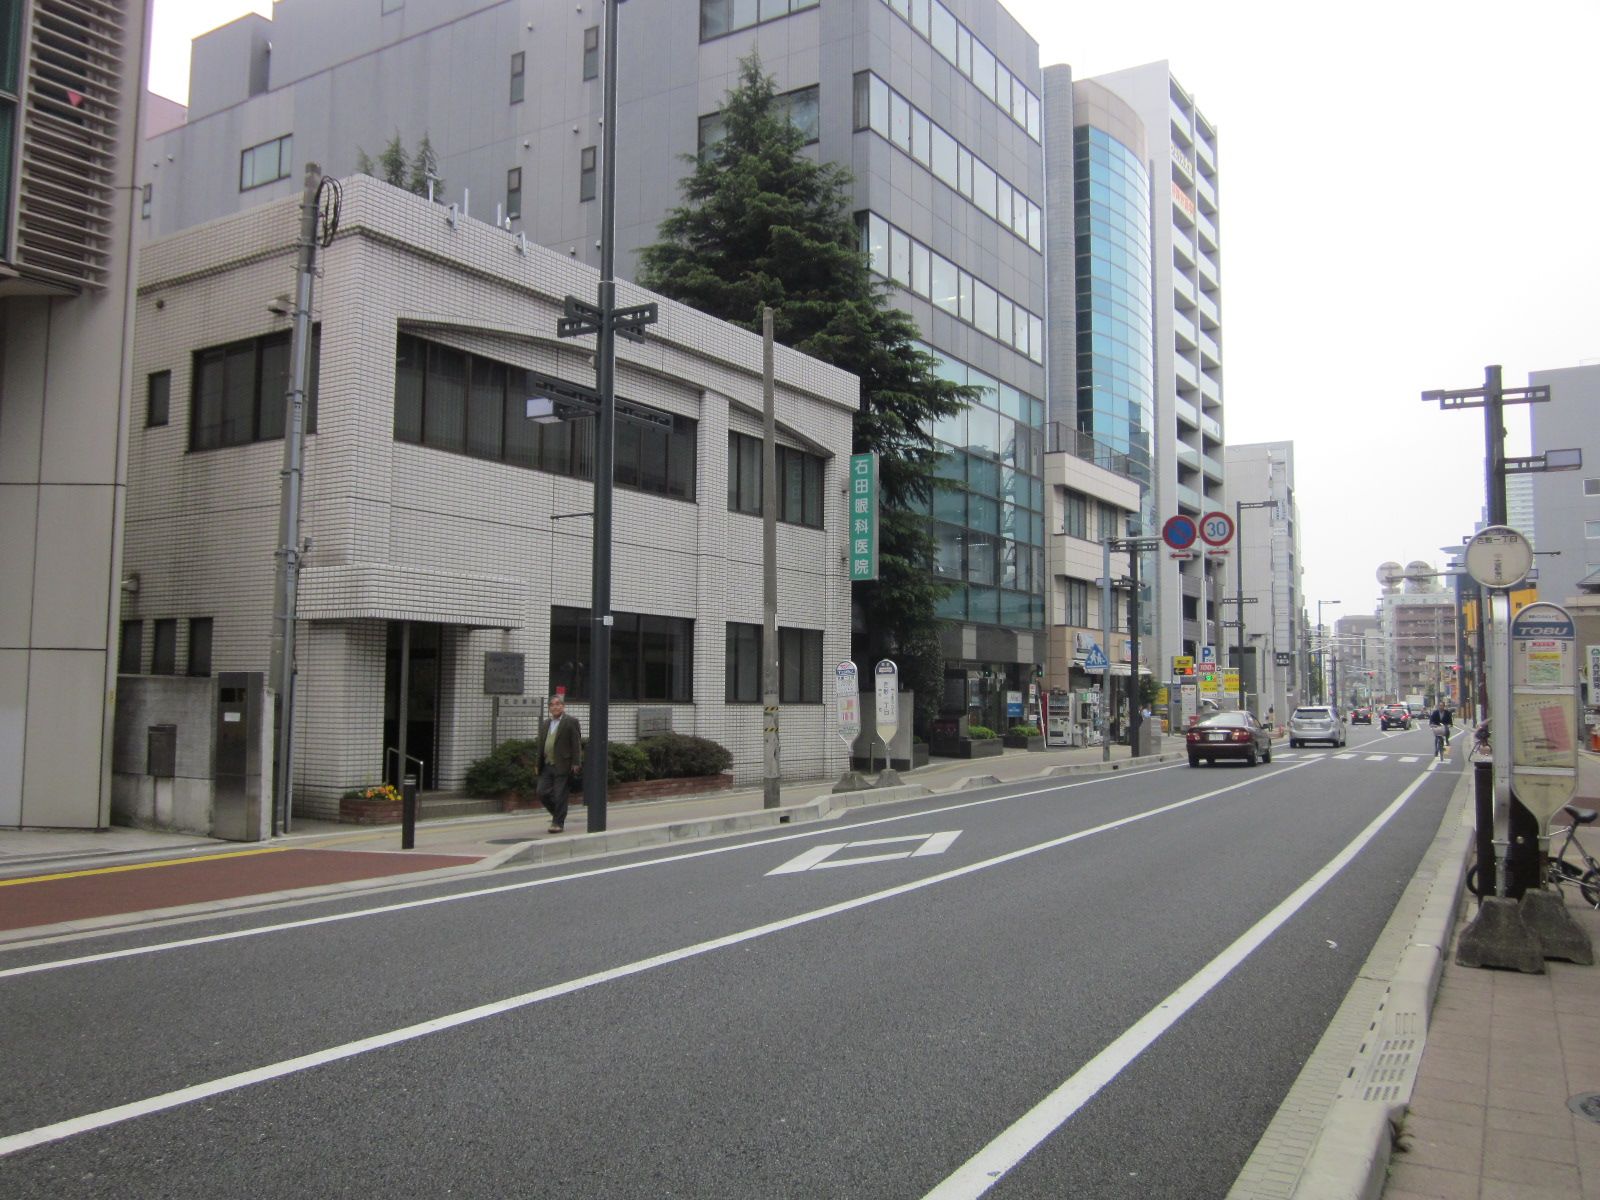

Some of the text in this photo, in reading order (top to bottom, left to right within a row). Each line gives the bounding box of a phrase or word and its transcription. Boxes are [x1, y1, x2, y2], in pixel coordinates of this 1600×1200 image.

[854, 459, 869, 575] 石田眼科医院
[1207, 521, 1226, 536] 30
[1520, 627, 1568, 635] TOBU
